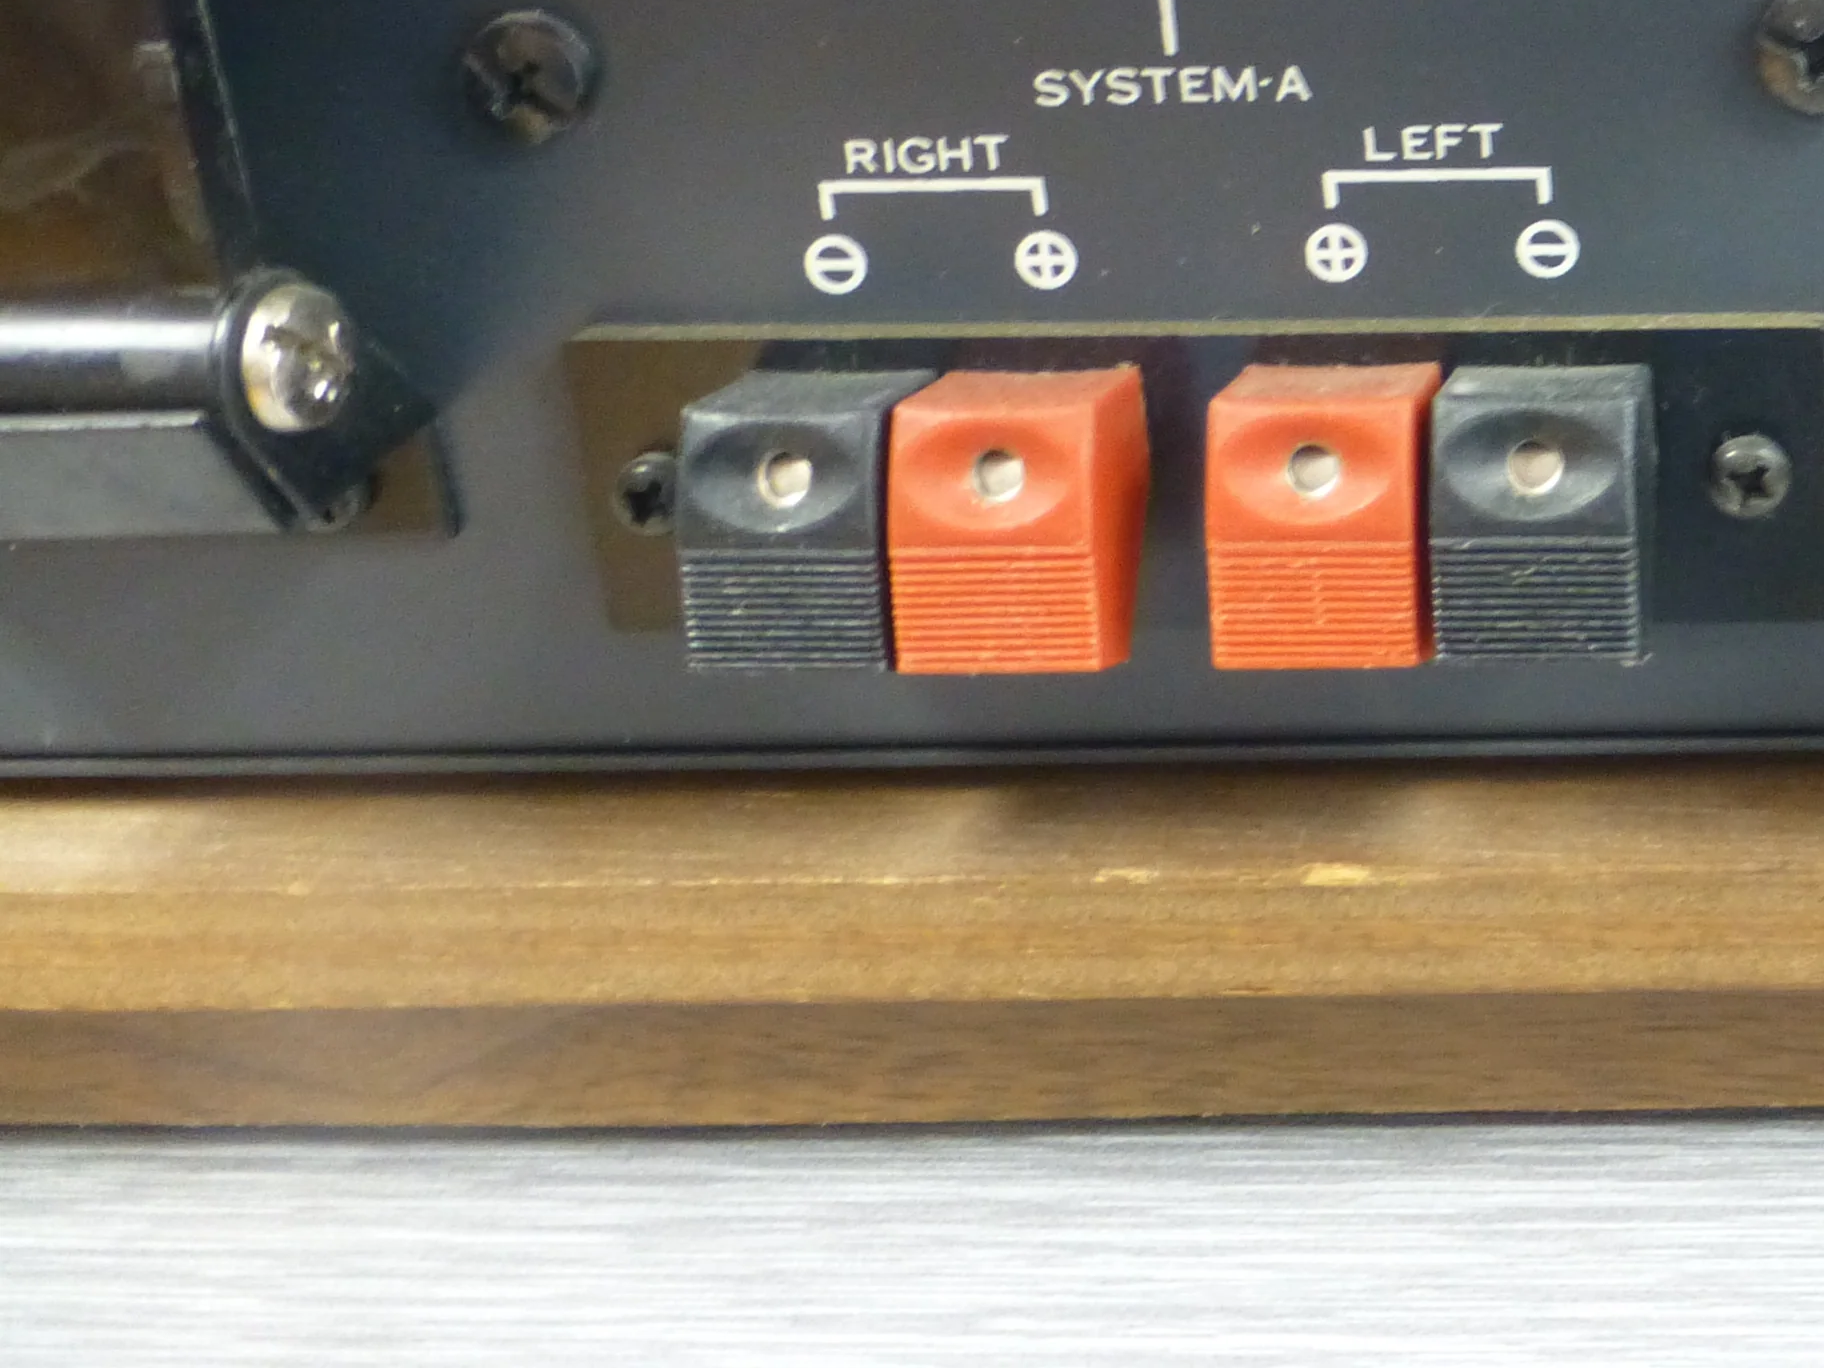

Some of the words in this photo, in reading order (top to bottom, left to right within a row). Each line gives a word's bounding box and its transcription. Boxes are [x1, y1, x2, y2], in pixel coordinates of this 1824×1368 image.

[1033, 66, 1314, 108] SYSTEM-A
[843, 135, 1010, 175] RIGHT
[1362, 122, 1504, 162] LEFT
